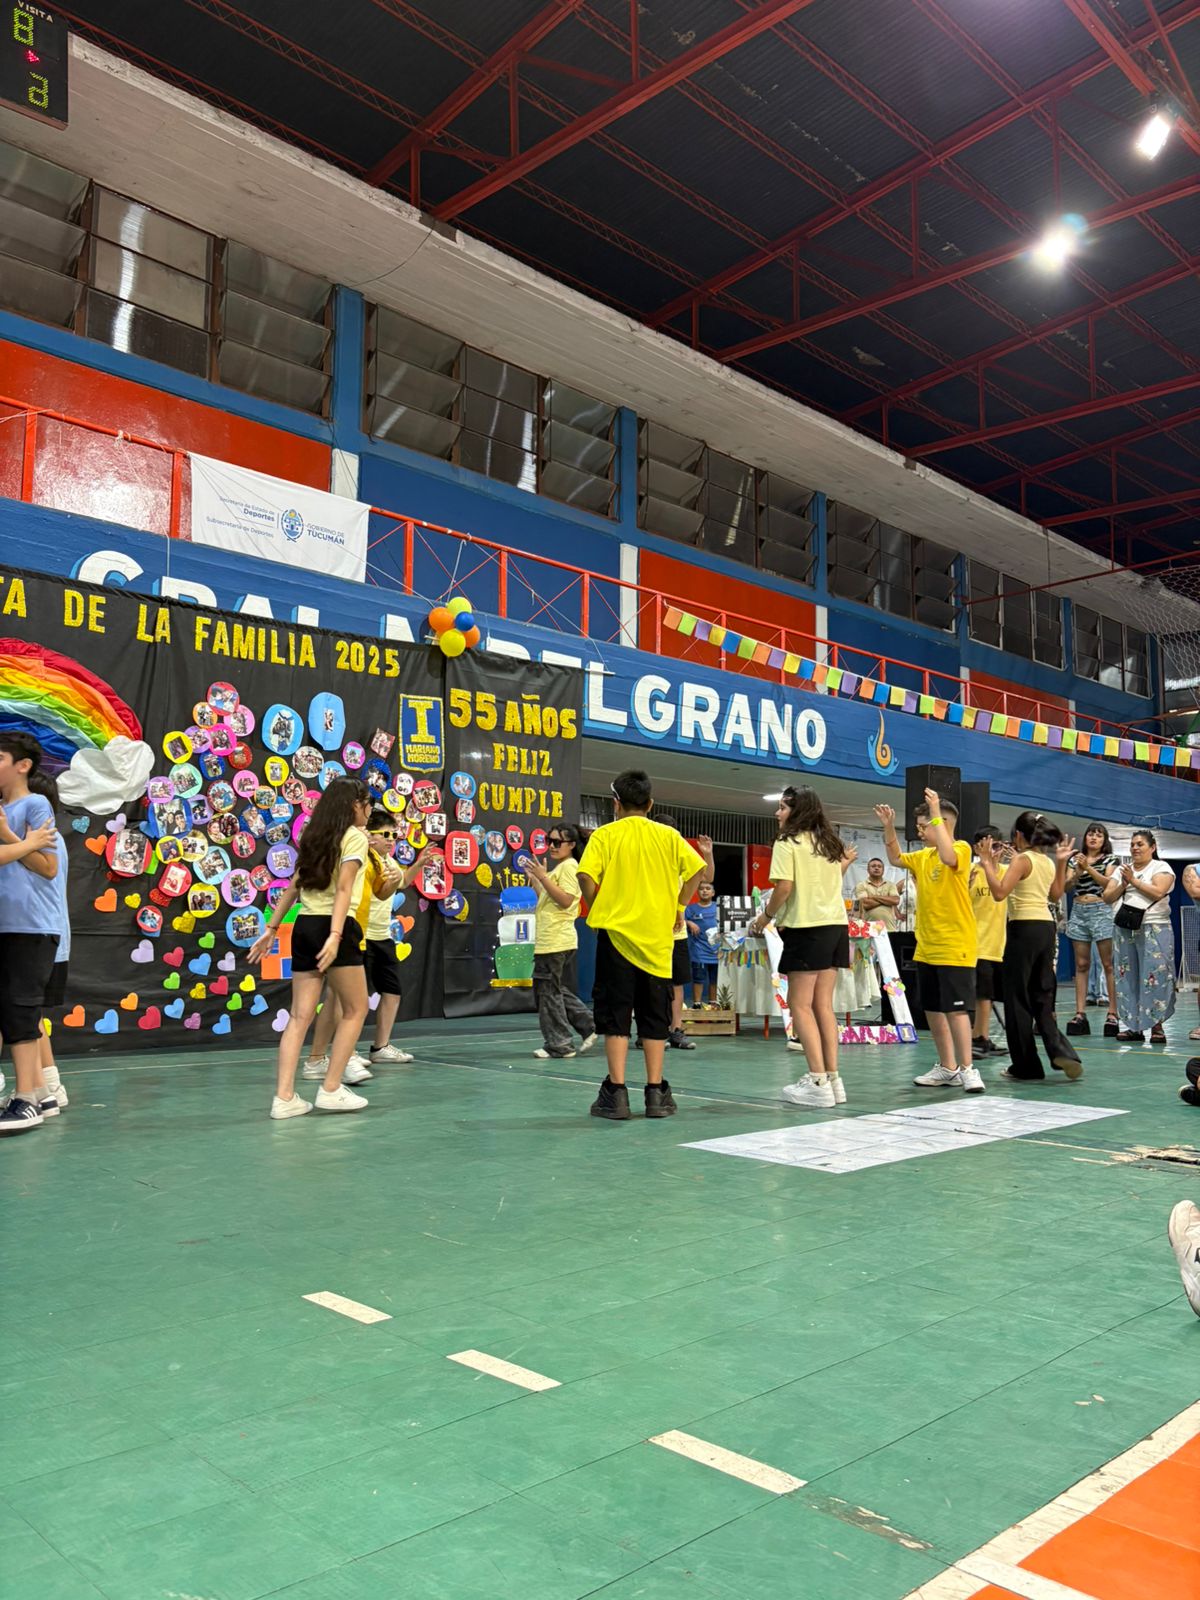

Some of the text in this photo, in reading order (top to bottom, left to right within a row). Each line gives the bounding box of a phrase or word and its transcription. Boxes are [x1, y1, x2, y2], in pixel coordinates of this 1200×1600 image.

[17, 0, 54, 23] VISITA
[14, 8, 34, 46] 8
[243, 508, 275, 522] Deportes
[250, 527, 274, 539] Deportes
[0, 576, 27, 618] A
[63, 589, 107, 634] DE
[136, 604, 172, 644] LA
[194, 615, 317, 669] FAMILIA
[335, 639, 401, 678] 2025
[449, 687, 578, 740] 55 AÑOS
[405, 743, 440, 755] MARIANO
[407, 753, 440, 764] MORENO
[492, 742, 553, 777] FELIZ
[478, 781, 564, 818] CUMPLE
[511, 873, 526, 887] 55
